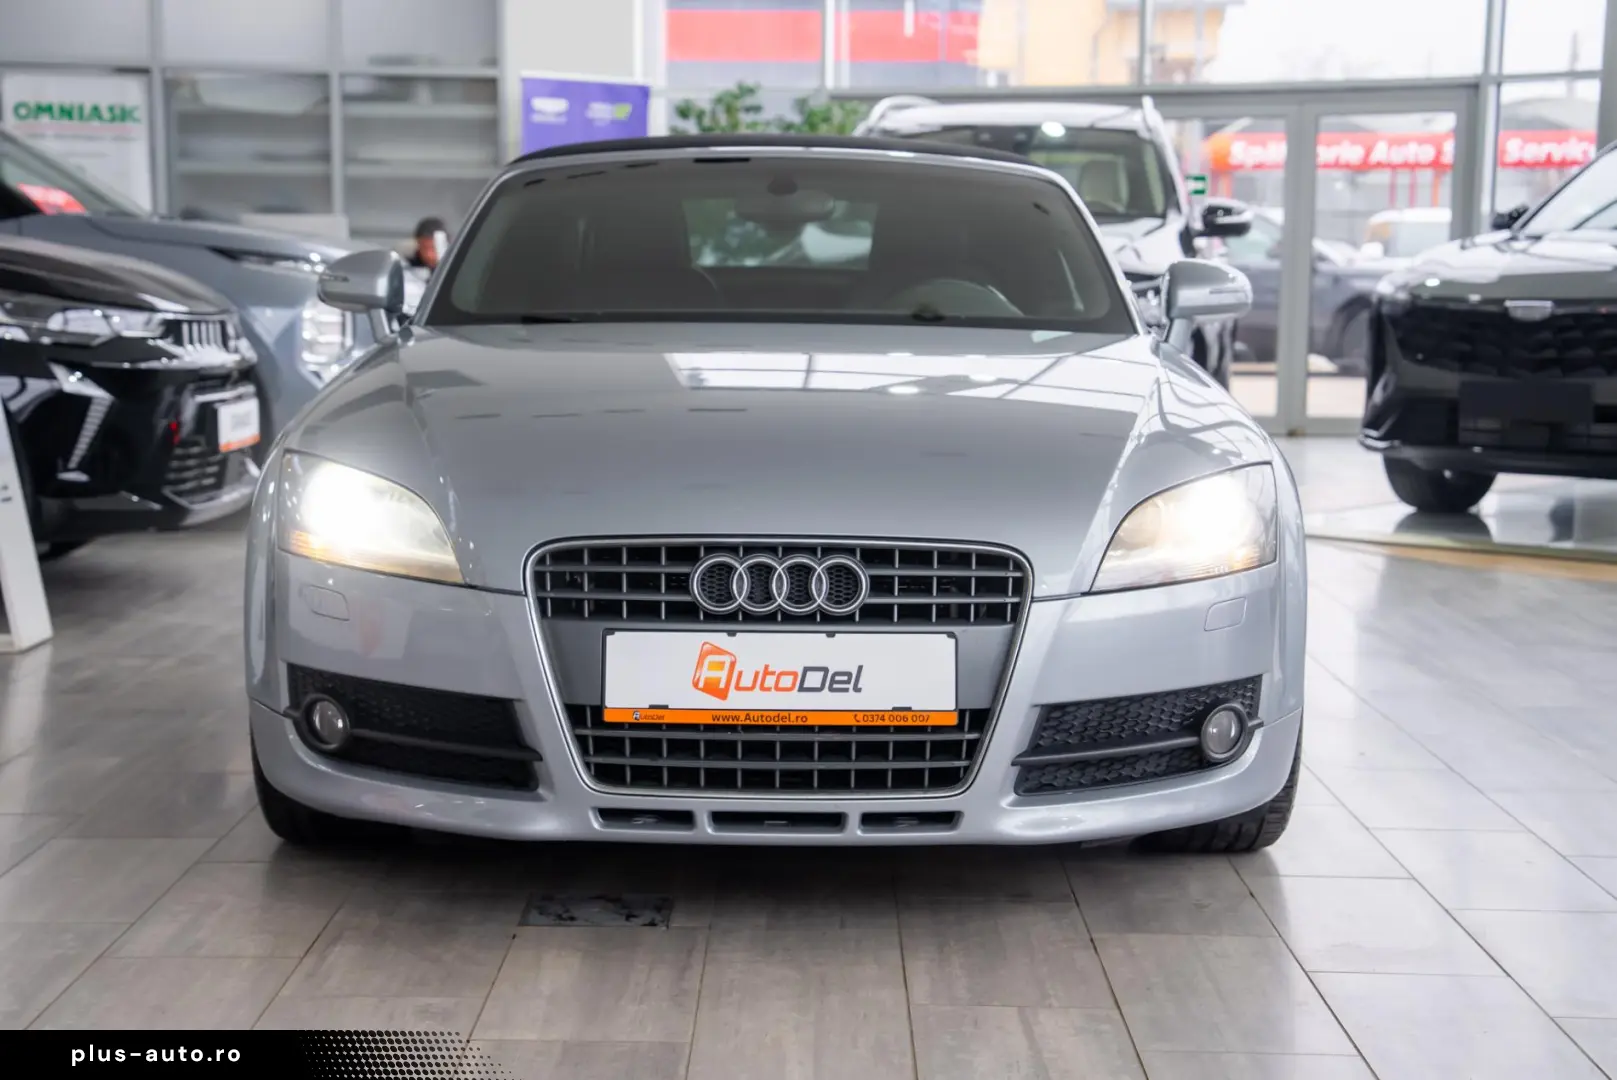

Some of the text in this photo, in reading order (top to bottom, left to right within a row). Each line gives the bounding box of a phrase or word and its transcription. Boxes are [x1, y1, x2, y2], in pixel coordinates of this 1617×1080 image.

[1368, 140, 1436, 164] Auto
[693, 645, 864, 698] AutoDel
[711, 712, 808, 724] www.Autodel.ro
[862, 713, 930, 723] 0374 006 007
